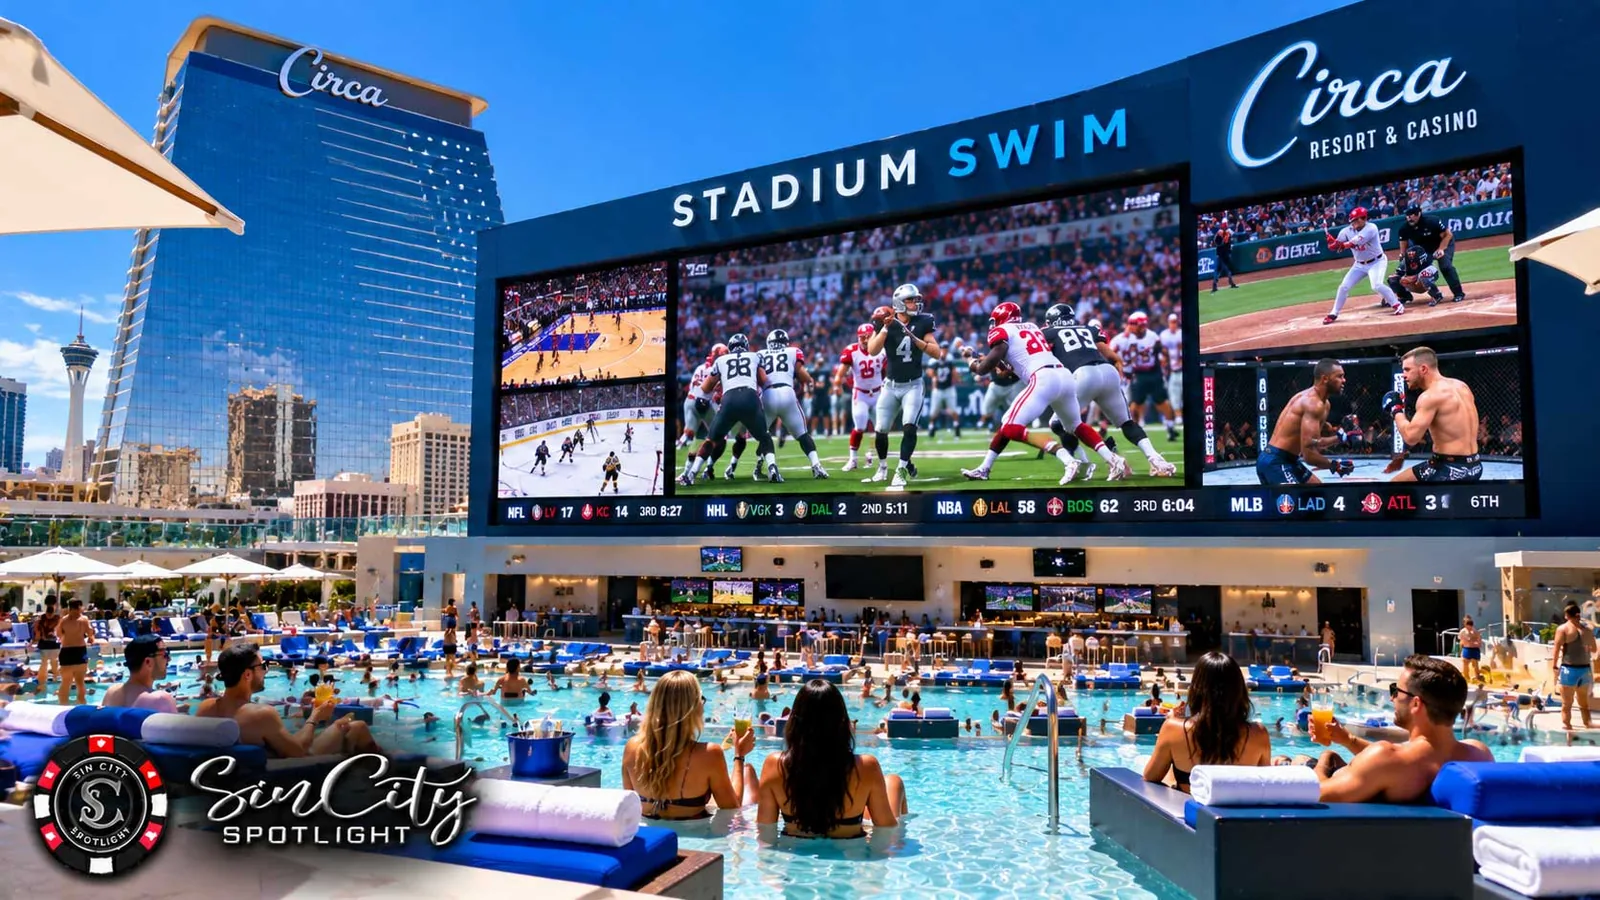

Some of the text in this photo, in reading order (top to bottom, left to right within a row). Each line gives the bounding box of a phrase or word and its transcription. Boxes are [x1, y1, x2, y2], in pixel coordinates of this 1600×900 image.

[279, 46, 389, 107] Circa
[1227, 40, 1467, 168] Circa
[1310, 108, 1478, 160] RESORT & CASINO
[672, 108, 1128, 227] STADIUM SWIM
[895, 335, 913, 363] 4
[507, 505, 682, 519] NFL LV 17 KC 14 3RD 8:27
[706, 502, 908, 517] NHL VGK 3 DAL 2 2ND 5:11
[937, 498, 1194, 515] NBA LAL 58 BOS 62 3RD 6:04
[1231, 497, 1263, 512] MLB
[1298, 497, 1326, 511] LAD
[1333, 496, 1346, 511] 4
[1387, 495, 1416, 510] ATL
[1470, 495, 1500, 508] 6TH
